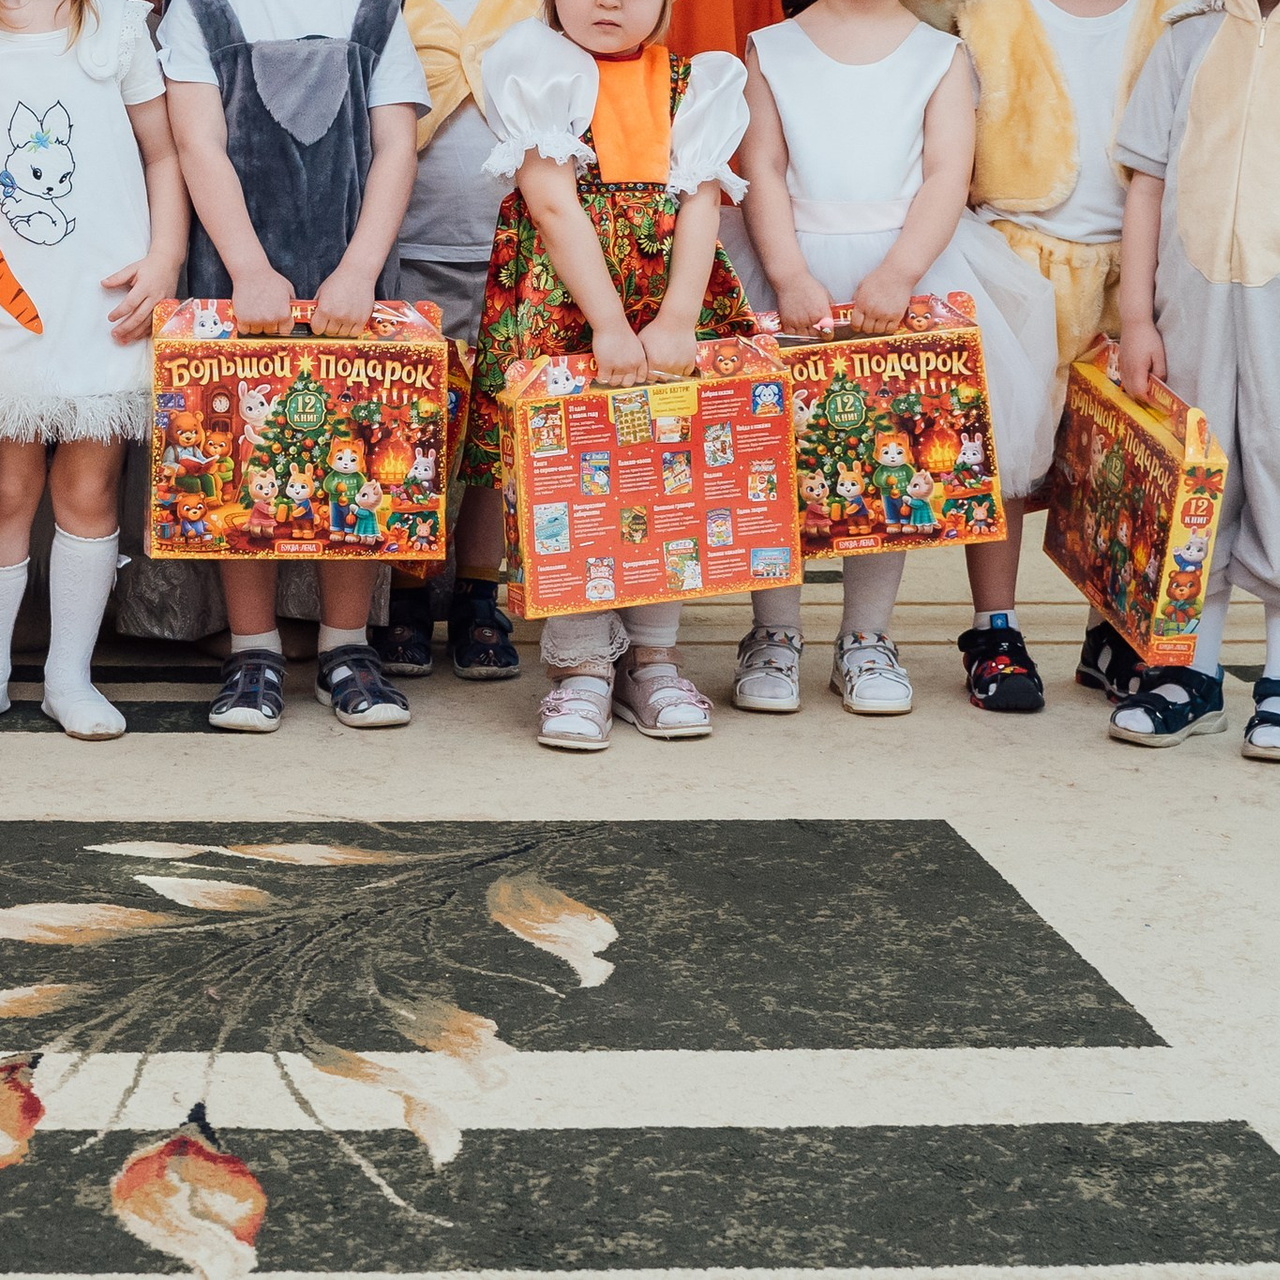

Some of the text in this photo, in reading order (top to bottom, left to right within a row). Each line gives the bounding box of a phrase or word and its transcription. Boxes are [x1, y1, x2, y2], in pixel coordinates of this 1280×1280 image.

[296, 397, 316, 413] 12
[836, 396, 855, 412] 12
[294, 414, 318, 422] КНИГ
[835, 412, 858, 422] КНИГ
[1189, 499, 1209, 515] 12
[1184, 516, 1209, 524] КНИГ
